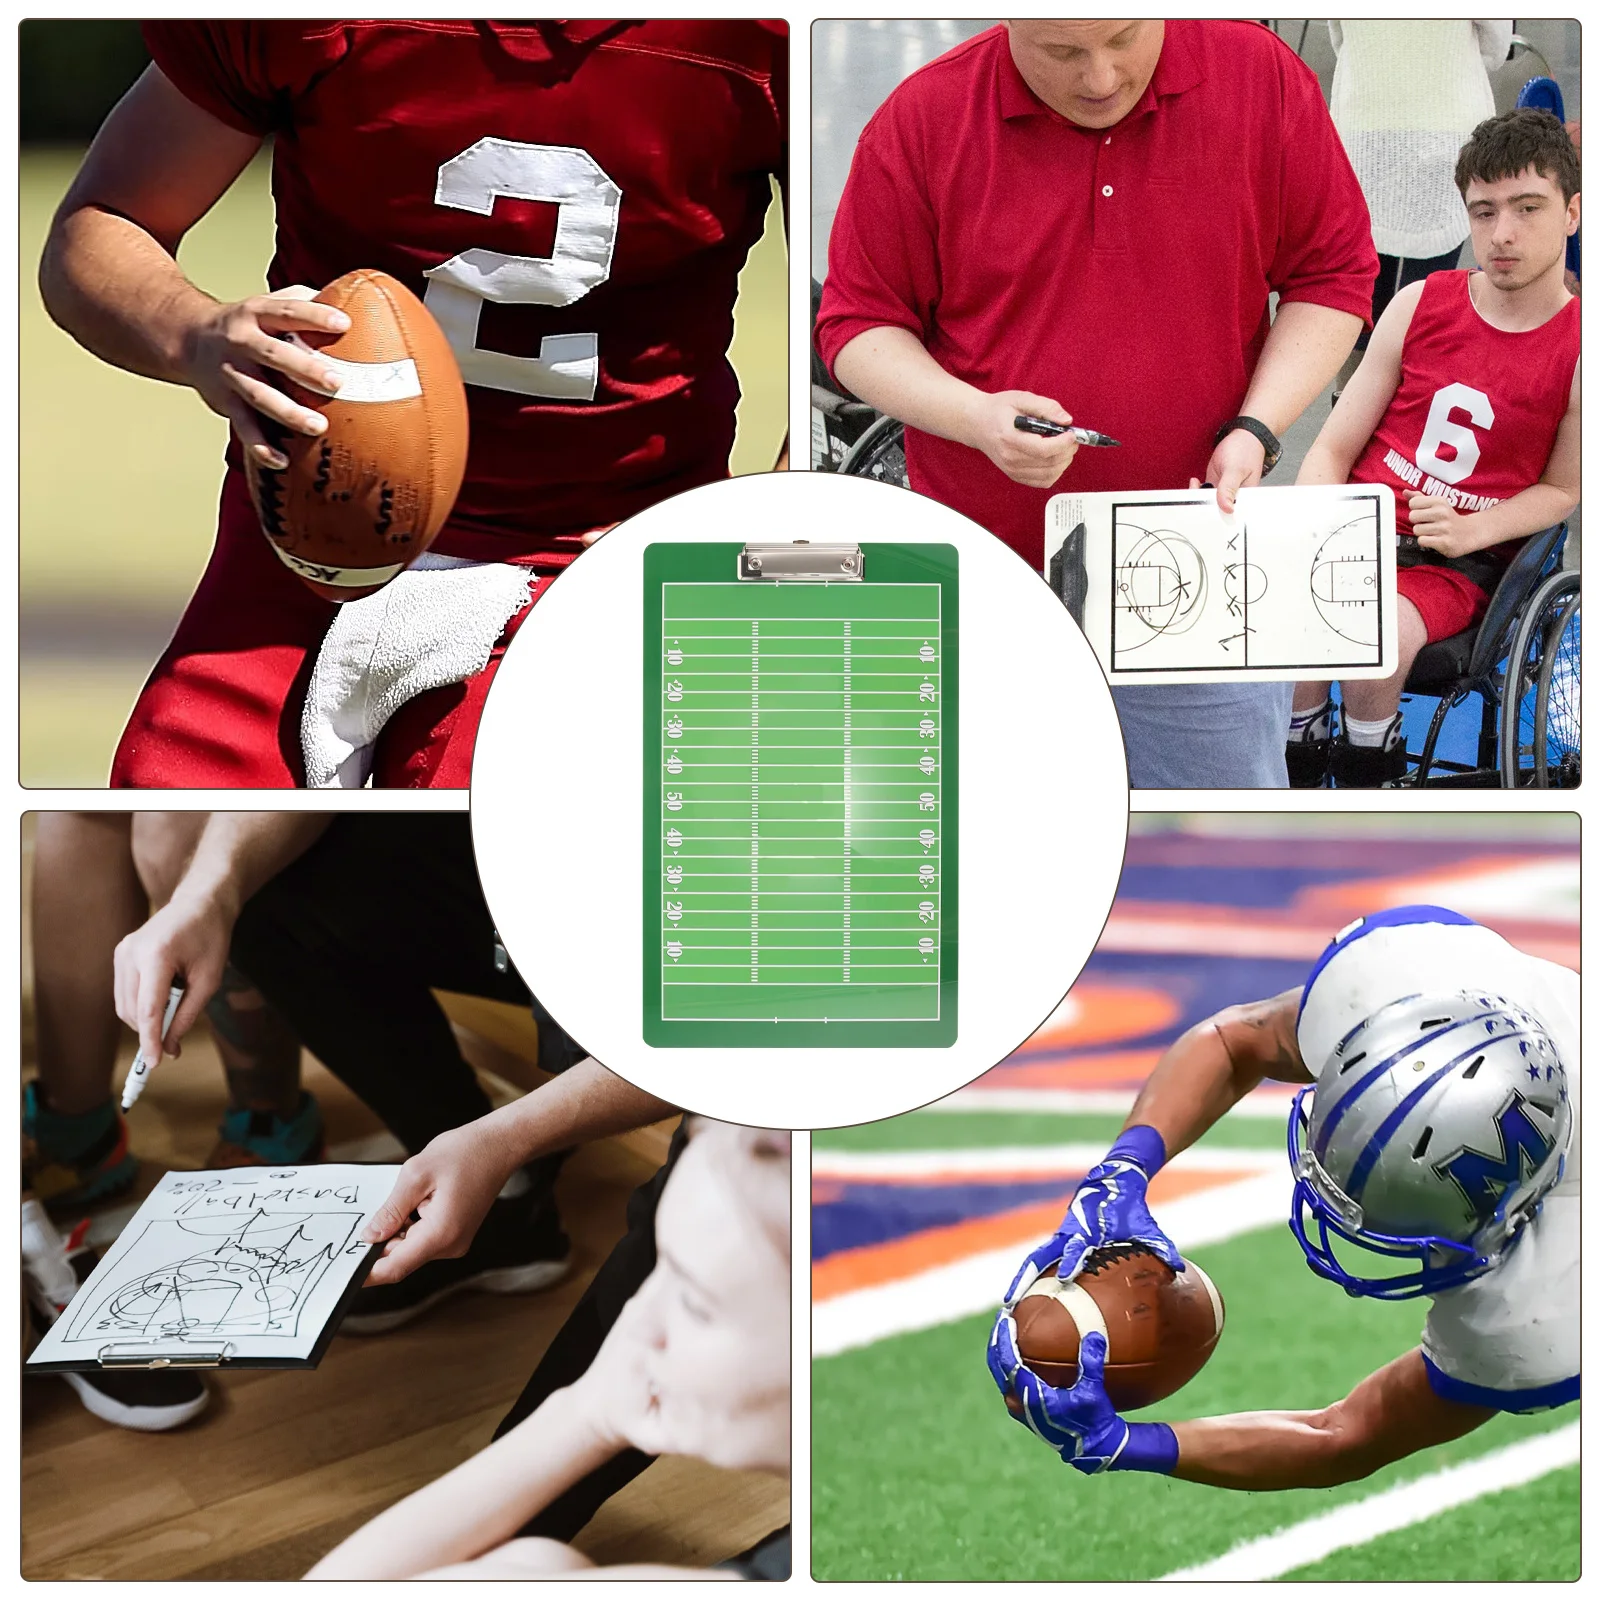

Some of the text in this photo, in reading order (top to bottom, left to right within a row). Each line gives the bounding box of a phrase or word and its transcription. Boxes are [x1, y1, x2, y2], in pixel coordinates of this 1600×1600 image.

[422, 136, 622, 401] 2
[1415, 382, 1495, 485] 6
[1383, 448, 1507, 512] JUNIOR MUSTANG
[667, 648, 683, 666] 10
[919, 646, 935, 663] 10
[667, 682, 683, 702] 20
[919, 682, 935, 702] 20
[667, 719, 683, 738] 30
[919, 719, 935, 738] 30
[667, 754, 683, 774] 40
[919, 756, 935, 776] 40
[667, 792, 683, 811] 50
[919, 792, 935, 812] 50
[667, 828, 683, 848] 40
[919, 829, 935, 848] 40
[667, 865, 683, 884] 30
[919, 864, 935, 884] 30
[667, 900, 683, 921] 20
[919, 901, 935, 920] 20
[667, 940, 683, 958] 10
[919, 938, 935, 954] 10
